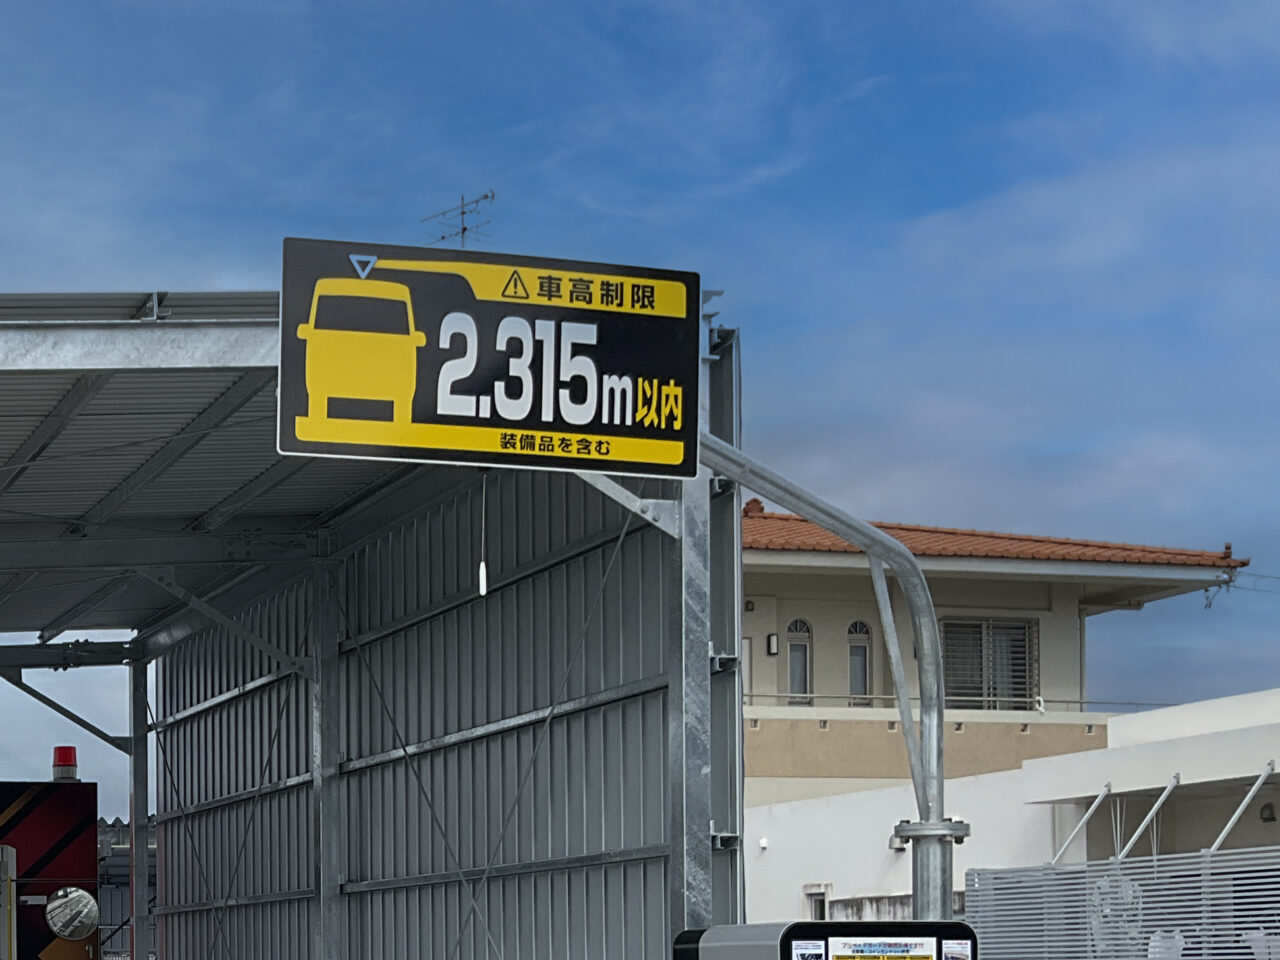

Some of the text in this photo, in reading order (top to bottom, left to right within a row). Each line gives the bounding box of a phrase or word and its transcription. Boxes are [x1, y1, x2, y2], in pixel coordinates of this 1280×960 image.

[536, 274, 656, 311] 車高制限
[499, 432, 611, 456] 装備品を含む
